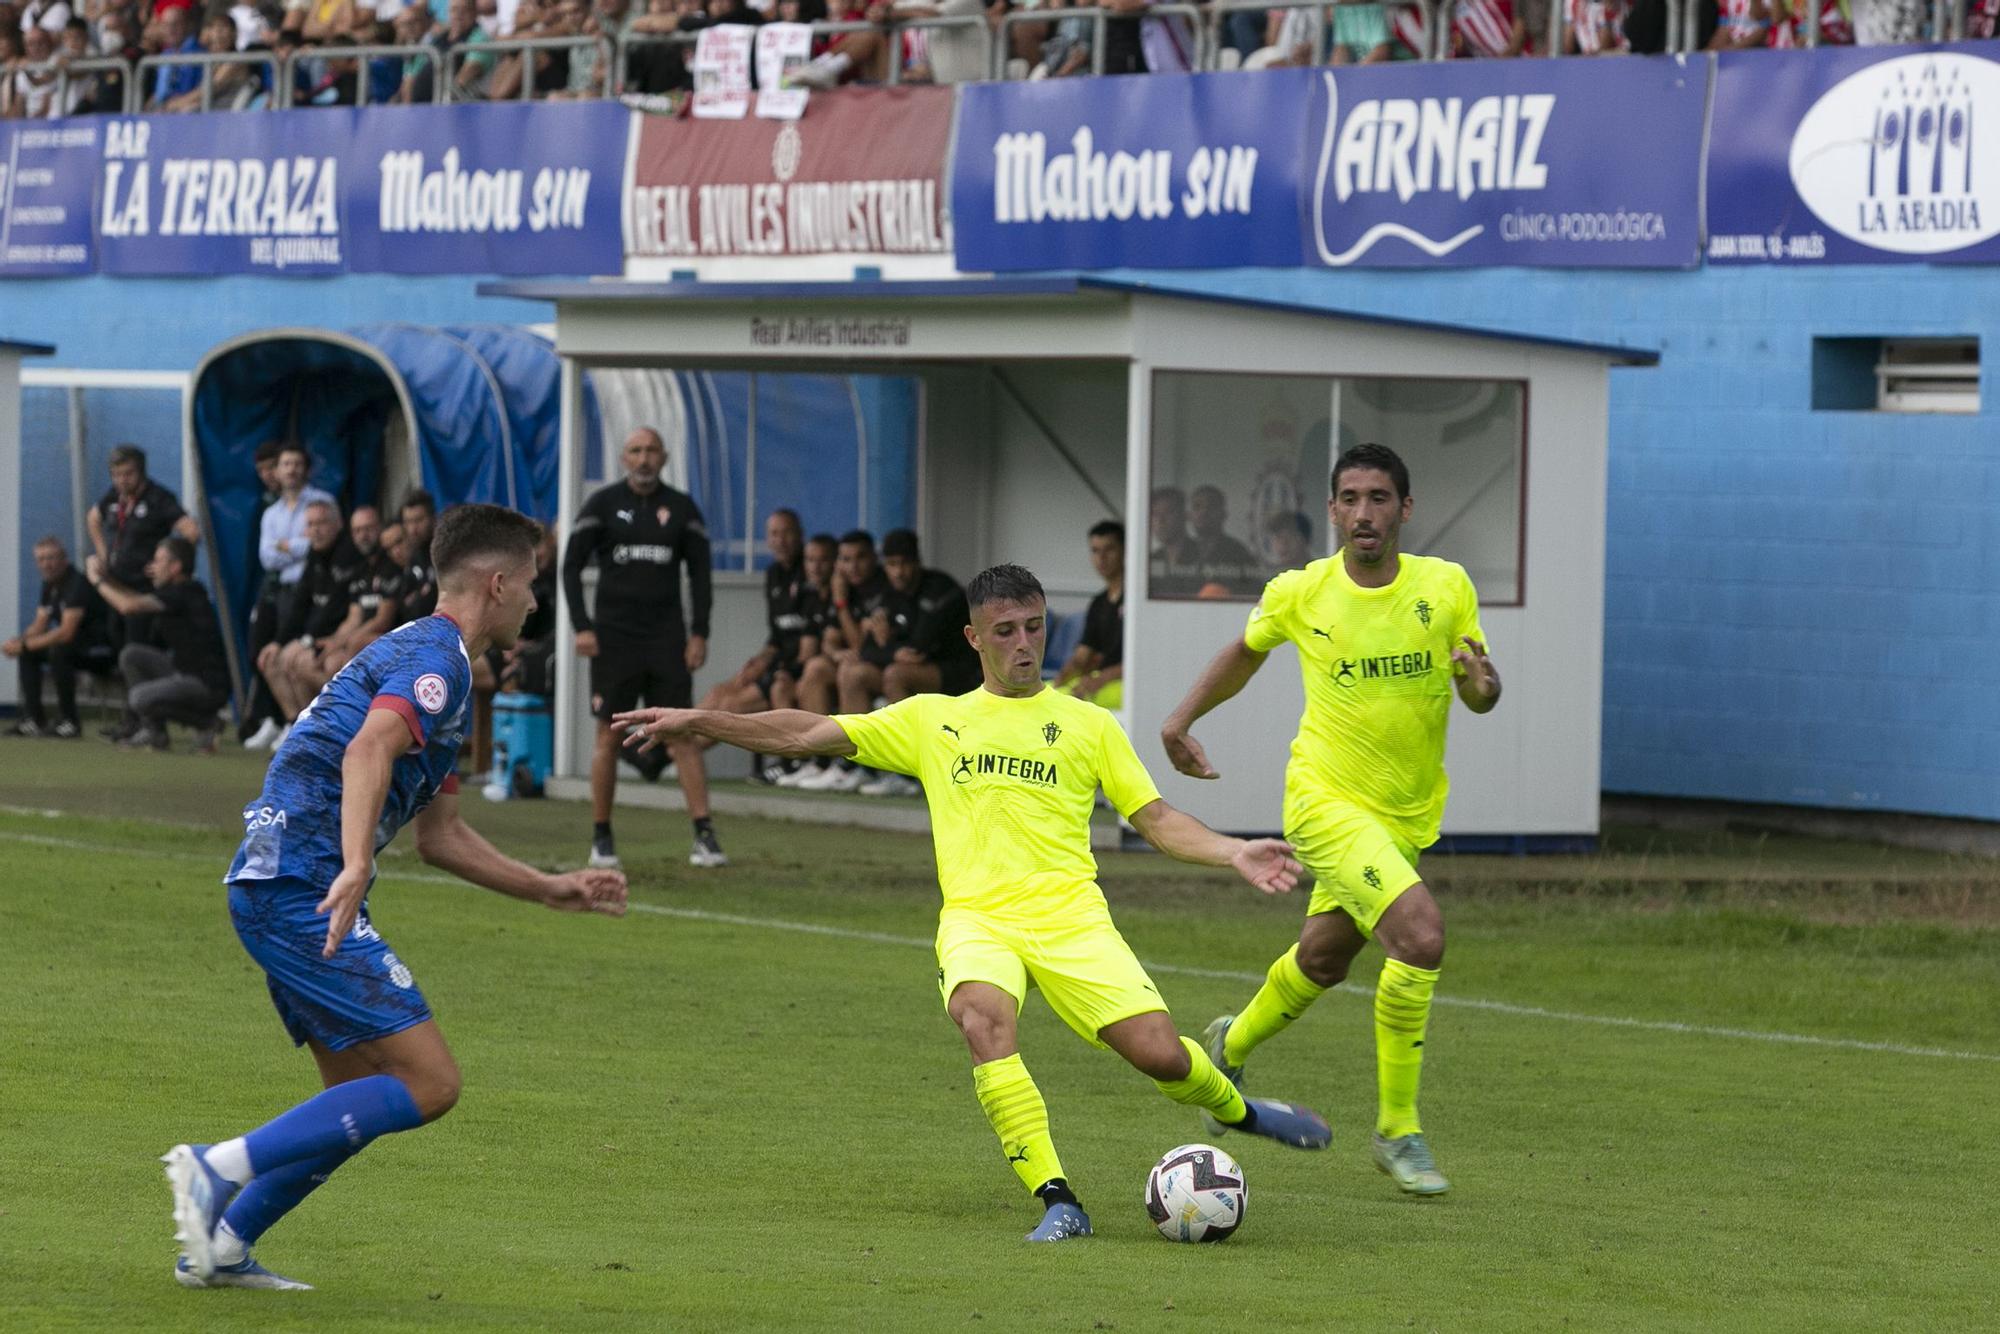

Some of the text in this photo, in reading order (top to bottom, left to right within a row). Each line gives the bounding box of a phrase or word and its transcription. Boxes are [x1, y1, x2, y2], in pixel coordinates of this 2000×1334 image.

[105, 121, 150, 159] BAR
[994, 125, 1258, 223] Mahou SIN
[1334, 94, 1556, 203] ARNAIZ
[101, 160, 149, 237] LA
[159, 155, 338, 236] TERRAZA
[380, 146, 591, 232] Mahou SIN
[634, 178, 943, 254] REAL AVILES INDUSTRIAL
[1860, 201, 1888, 233] LA
[1361, 650, 1433, 678] INTEGRA
[977, 754, 1058, 784] INTEGRA
